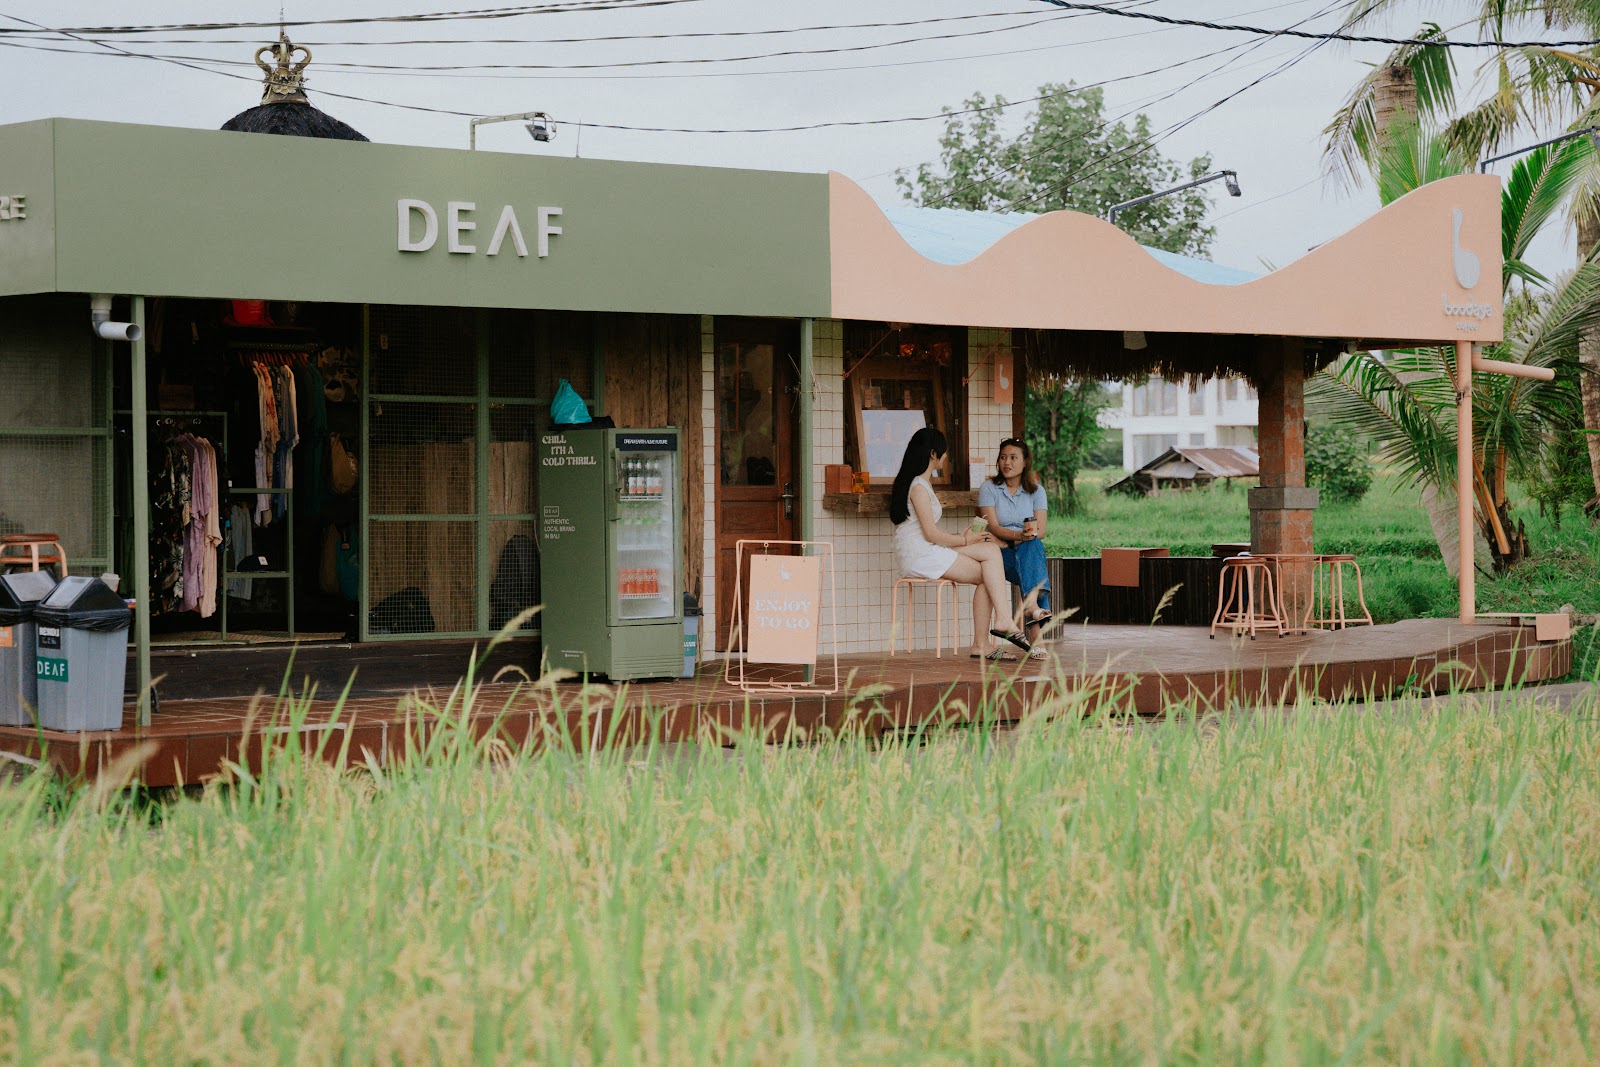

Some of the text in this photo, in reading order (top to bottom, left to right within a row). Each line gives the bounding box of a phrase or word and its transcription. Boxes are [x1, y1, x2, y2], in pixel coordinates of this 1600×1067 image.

[397, 199, 563, 257] DEAF
[542, 435, 566, 444] CHILL
[568, 446, 574, 455] A
[543, 456, 596, 466] COLD THRILL
[755, 599, 811, 613] ENJOY
[755, 616, 811, 630] TO GO
[37, 661, 65, 676] DEAF
